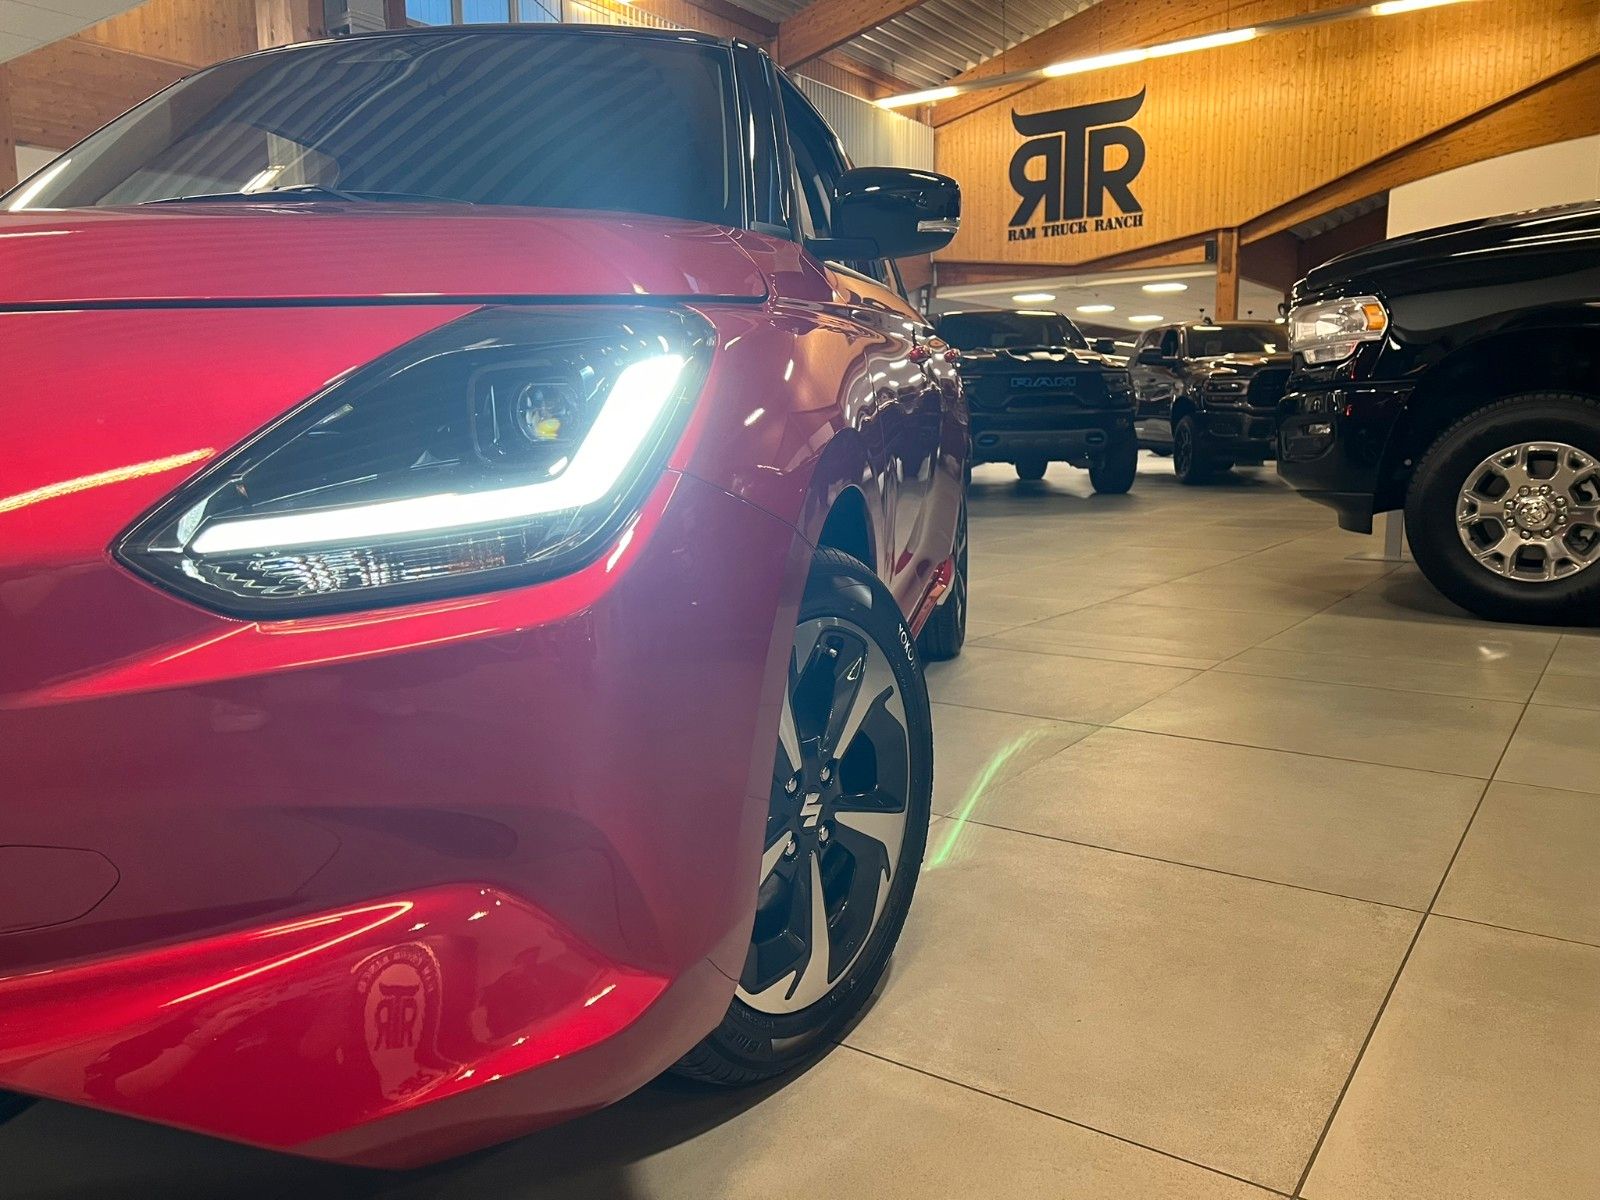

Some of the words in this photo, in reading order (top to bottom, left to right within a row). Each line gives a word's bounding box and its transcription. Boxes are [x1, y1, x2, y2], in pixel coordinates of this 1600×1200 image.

[1008, 227, 1036, 241] RAM
[1042, 221, 1088, 237] TRUCK
[1094, 214, 1143, 232] RANCH
[1010, 376, 1077, 388] RAM
[898, 623, 916, 671] YOKO
